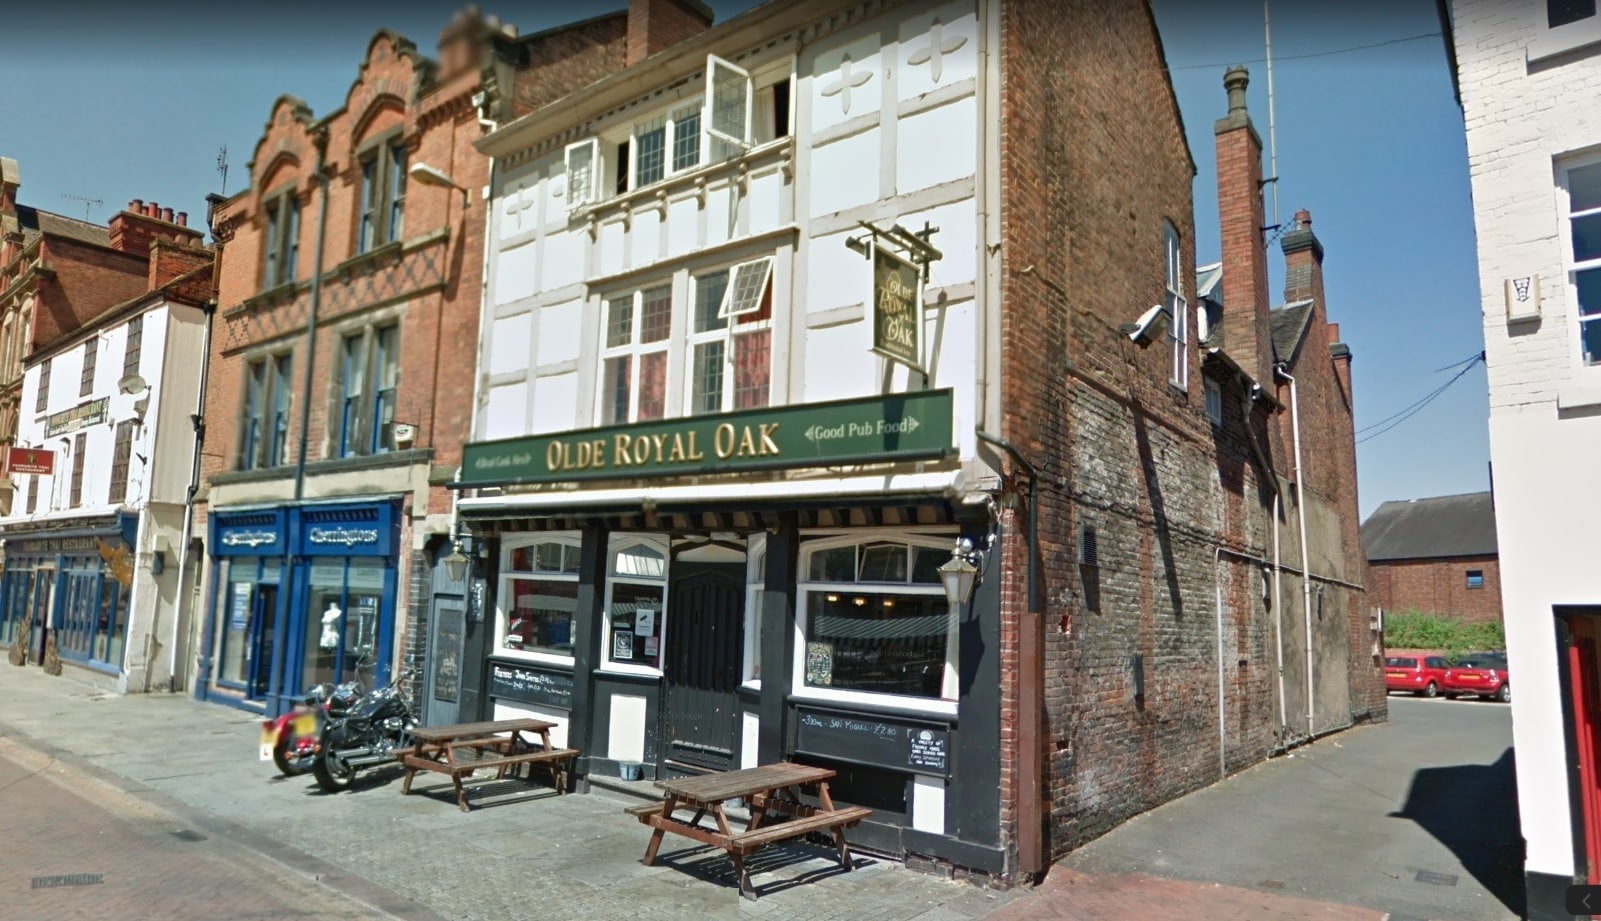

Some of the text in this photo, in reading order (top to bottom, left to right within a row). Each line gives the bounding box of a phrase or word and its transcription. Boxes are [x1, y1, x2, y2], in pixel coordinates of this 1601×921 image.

[883, 316, 914, 348] OAK
[815, 417, 907, 440] Good Pub Food
[547, 422, 780, 472] OLDE ROYAL OAK
